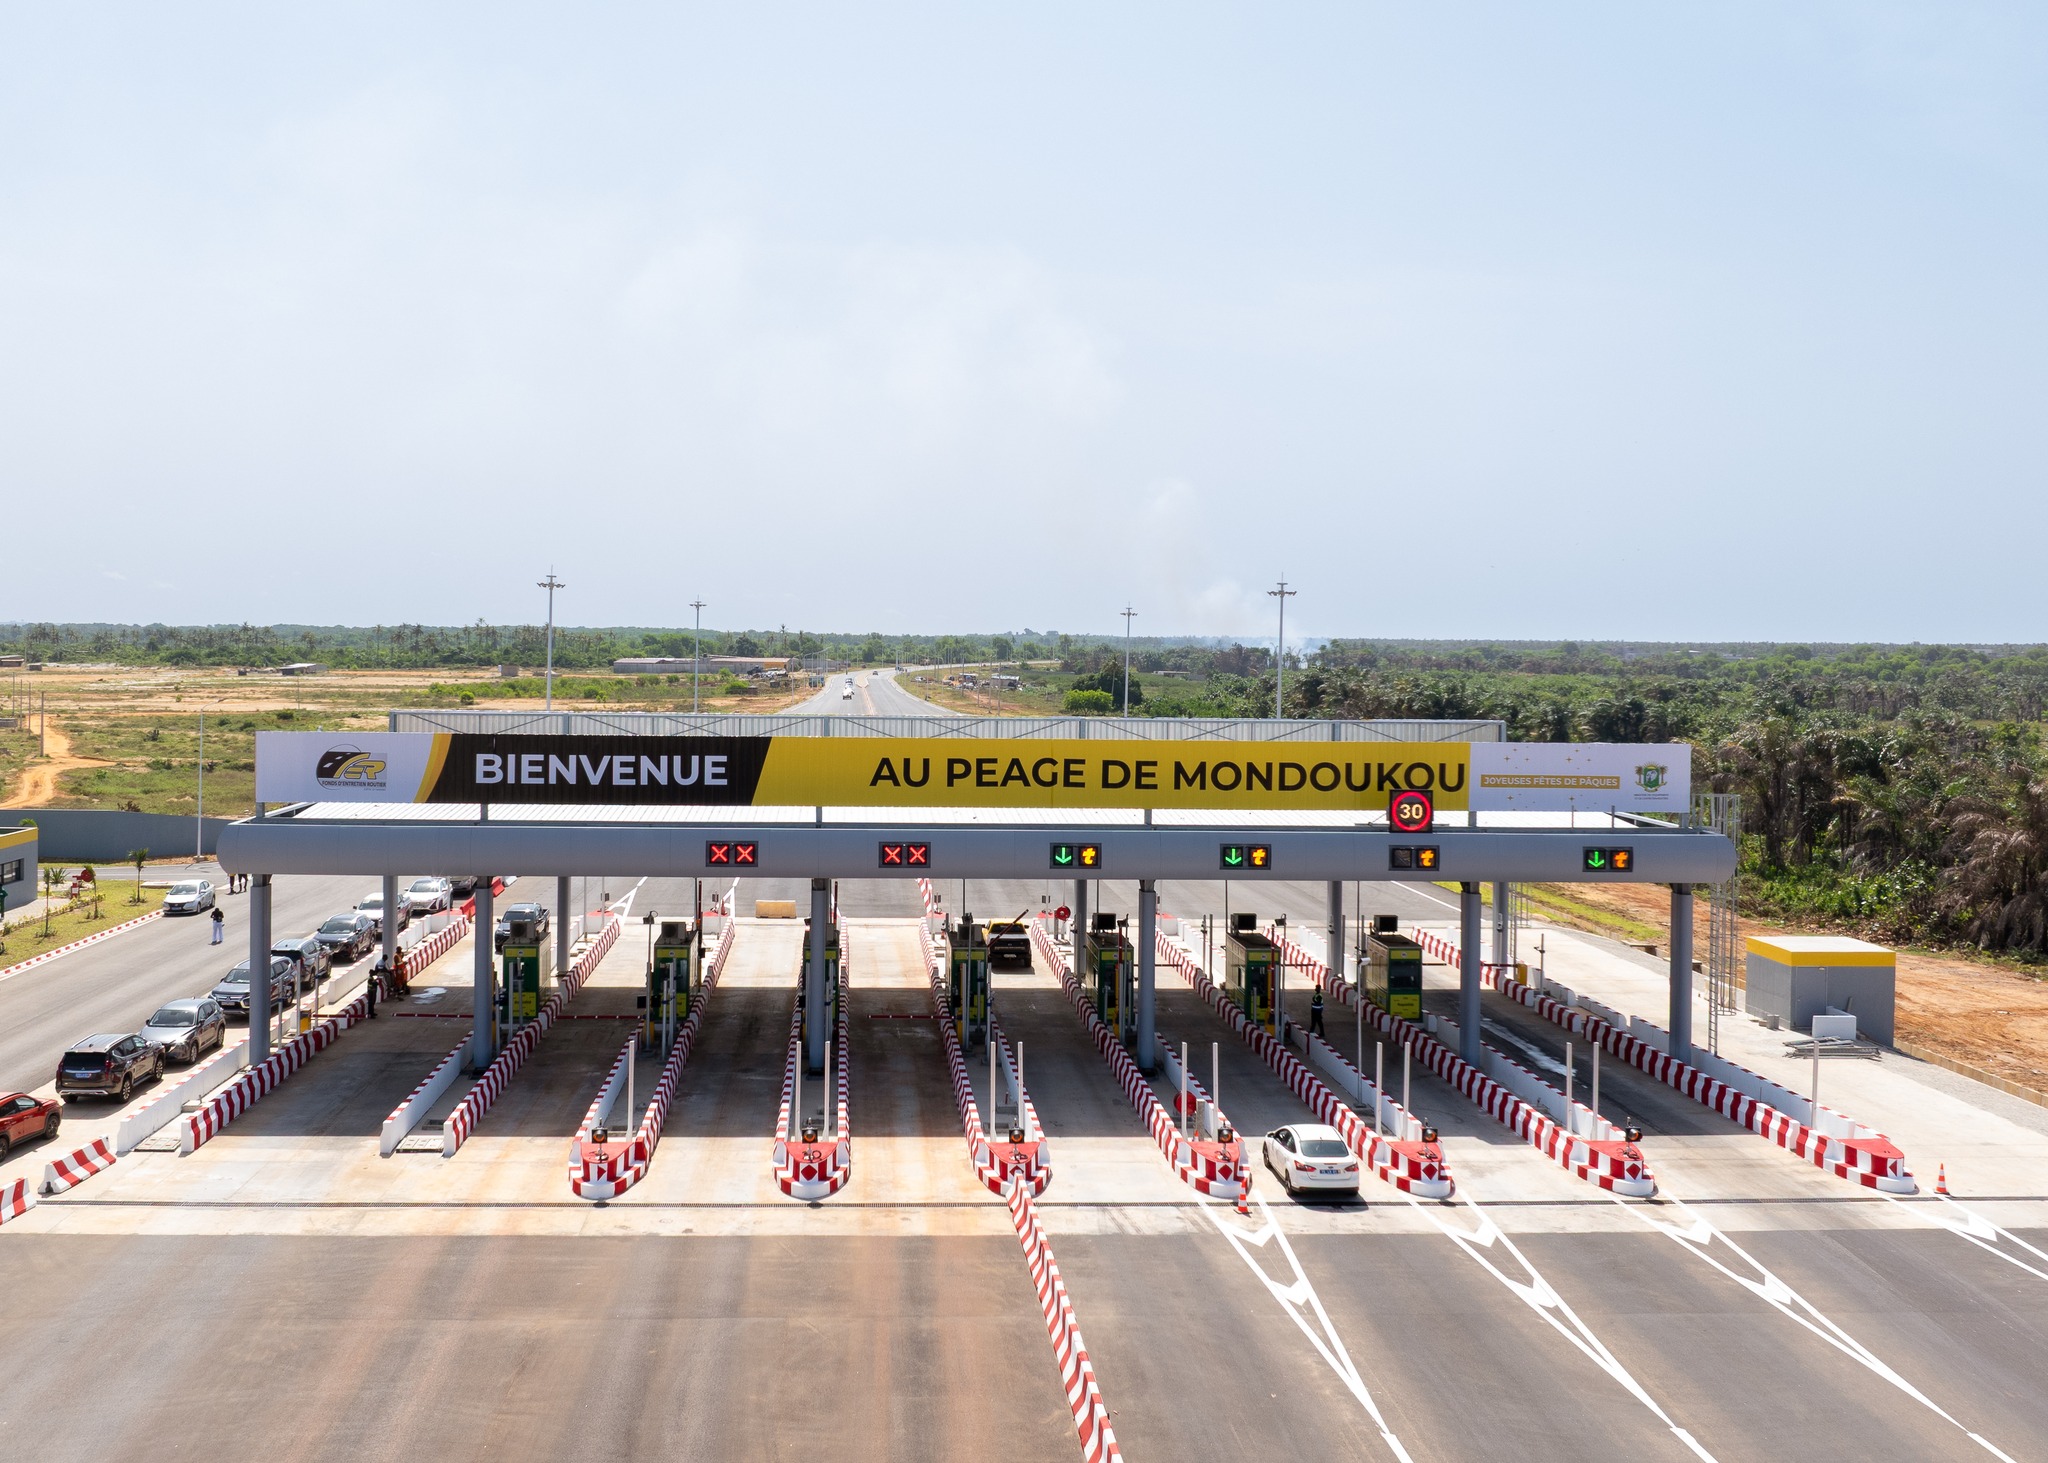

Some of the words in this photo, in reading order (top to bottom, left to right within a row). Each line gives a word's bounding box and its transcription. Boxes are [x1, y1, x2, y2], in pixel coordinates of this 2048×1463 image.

[475, 753, 728, 786] BIENVENUE
[869, 757, 930, 787] AU
[947, 757, 1086, 788] PEAGE
[1102, 760, 1158, 790] DE
[1173, 761, 1466, 792] MONDOUKOU
[1484, 776, 1532, 785] JOYEUSES
[1533, 776, 1562, 786] FÊTES
[1564, 778, 1577, 786] DE
[1579, 776, 1618, 787] PÂQUES
[1399, 803, 1424, 820] 30
